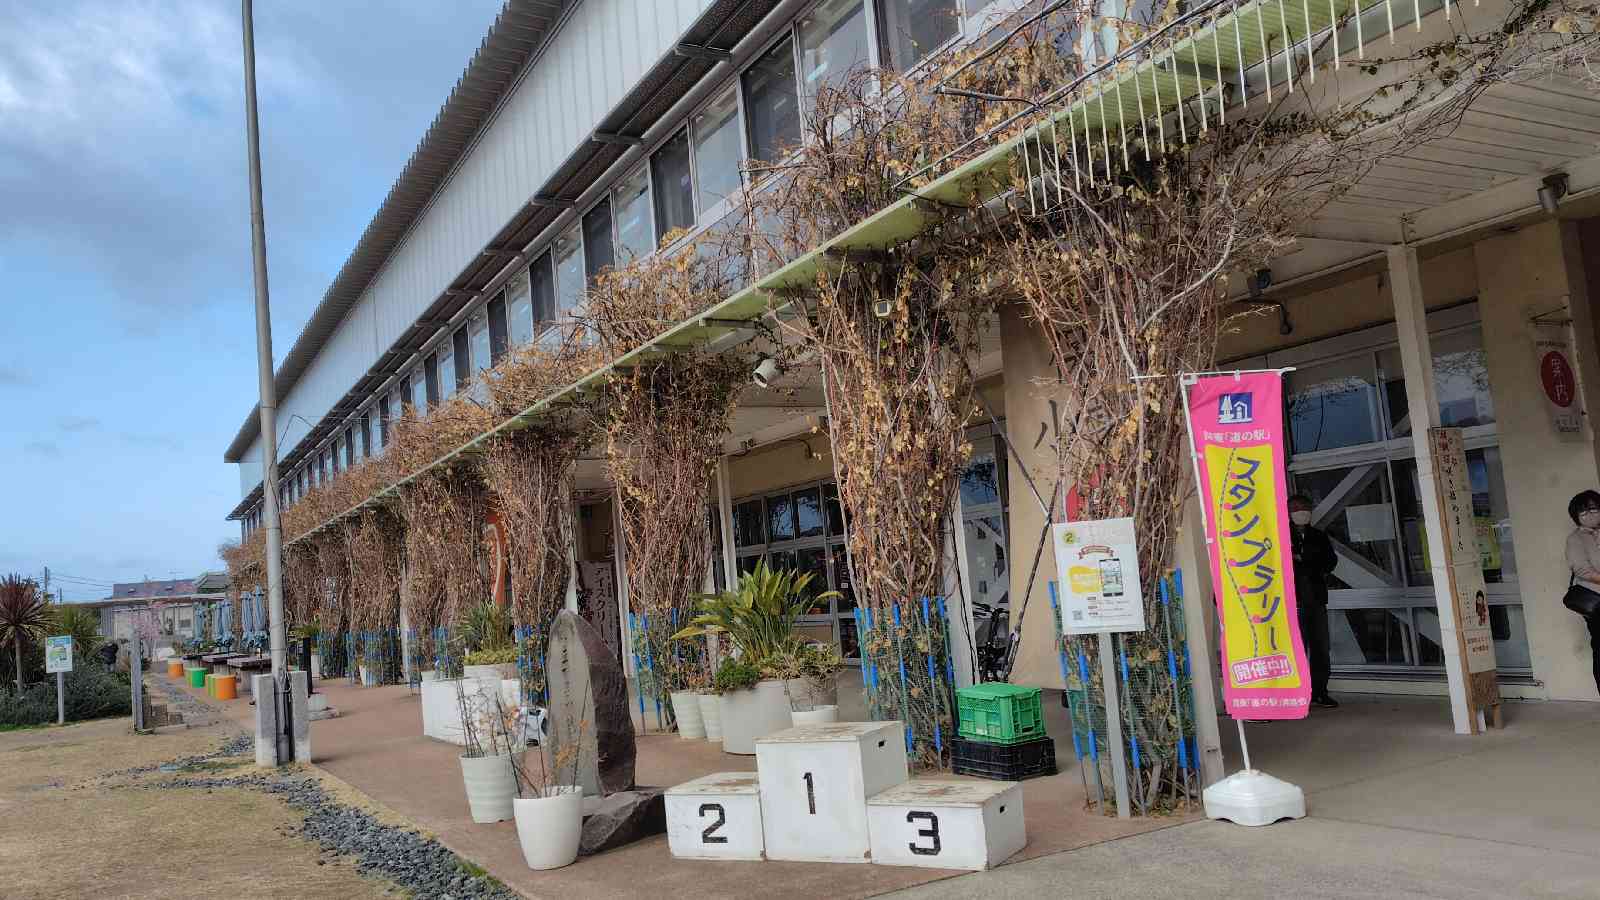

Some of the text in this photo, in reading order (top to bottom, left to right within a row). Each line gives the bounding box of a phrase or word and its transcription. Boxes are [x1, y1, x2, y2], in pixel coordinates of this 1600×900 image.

[1223, 456, 1281, 651] スタンプラリー
[802, 772, 816, 815] 1
[698, 803, 728, 844] 2
[906, 810, 941, 856] 3
